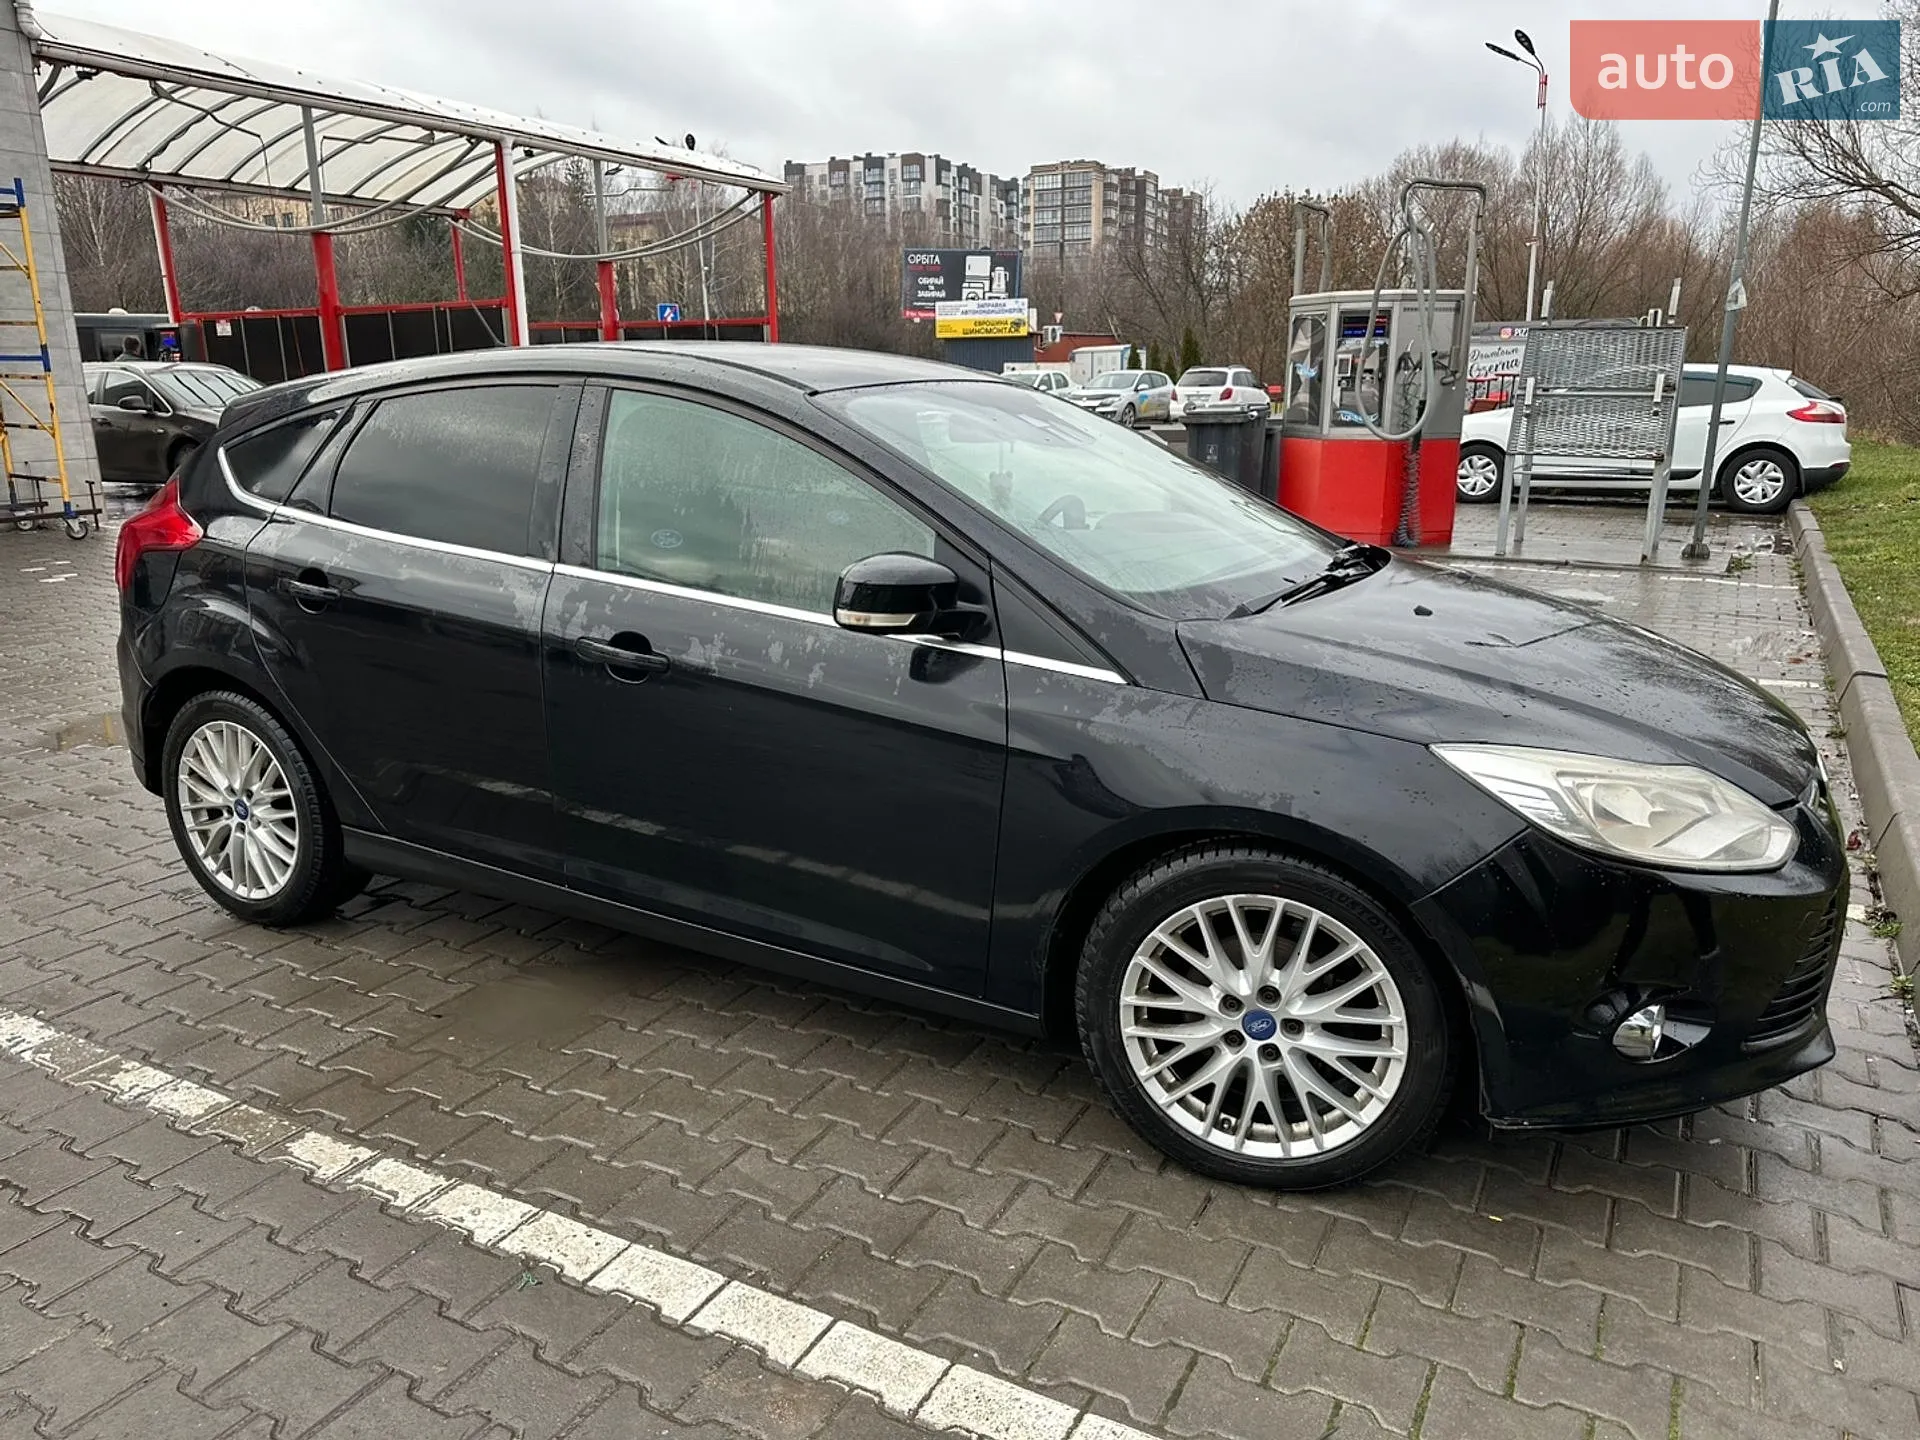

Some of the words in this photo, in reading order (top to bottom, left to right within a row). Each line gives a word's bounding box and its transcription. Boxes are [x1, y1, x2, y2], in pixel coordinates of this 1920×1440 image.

[908, 254, 940, 264] ОРБІТА
[962, 326, 1021, 335] ШИНОМОНТАЖ
[1469, 347, 1519, 361] Downtown
